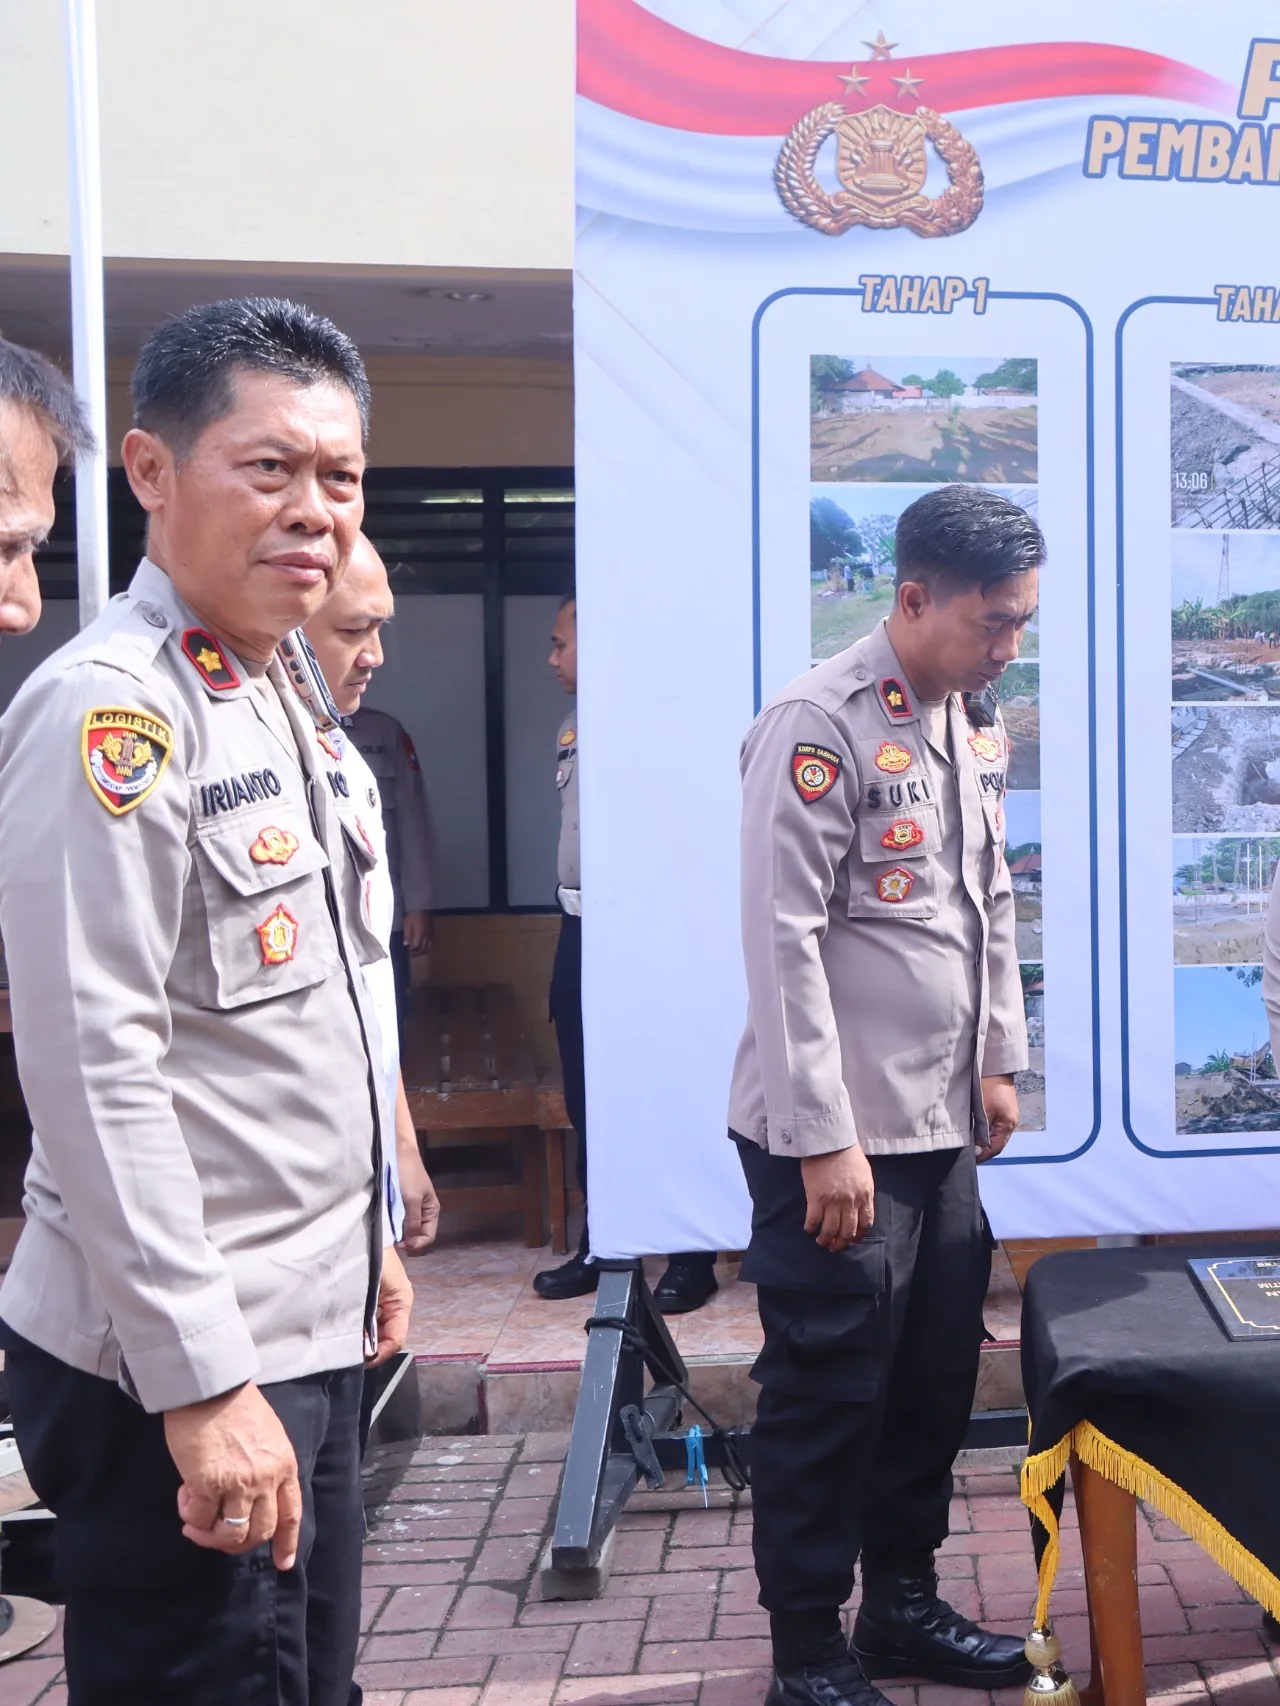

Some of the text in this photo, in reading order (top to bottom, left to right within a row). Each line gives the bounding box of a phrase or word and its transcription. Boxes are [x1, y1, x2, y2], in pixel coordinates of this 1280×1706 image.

[859, 275, 989, 315] TAHAP 1
[1175, 472, 1208, 489] 13:06
[92, 713, 167, 742] LOGISTIK
[201, 767, 282, 818] IRIANTO
[867, 778, 932, 810] SUKI
